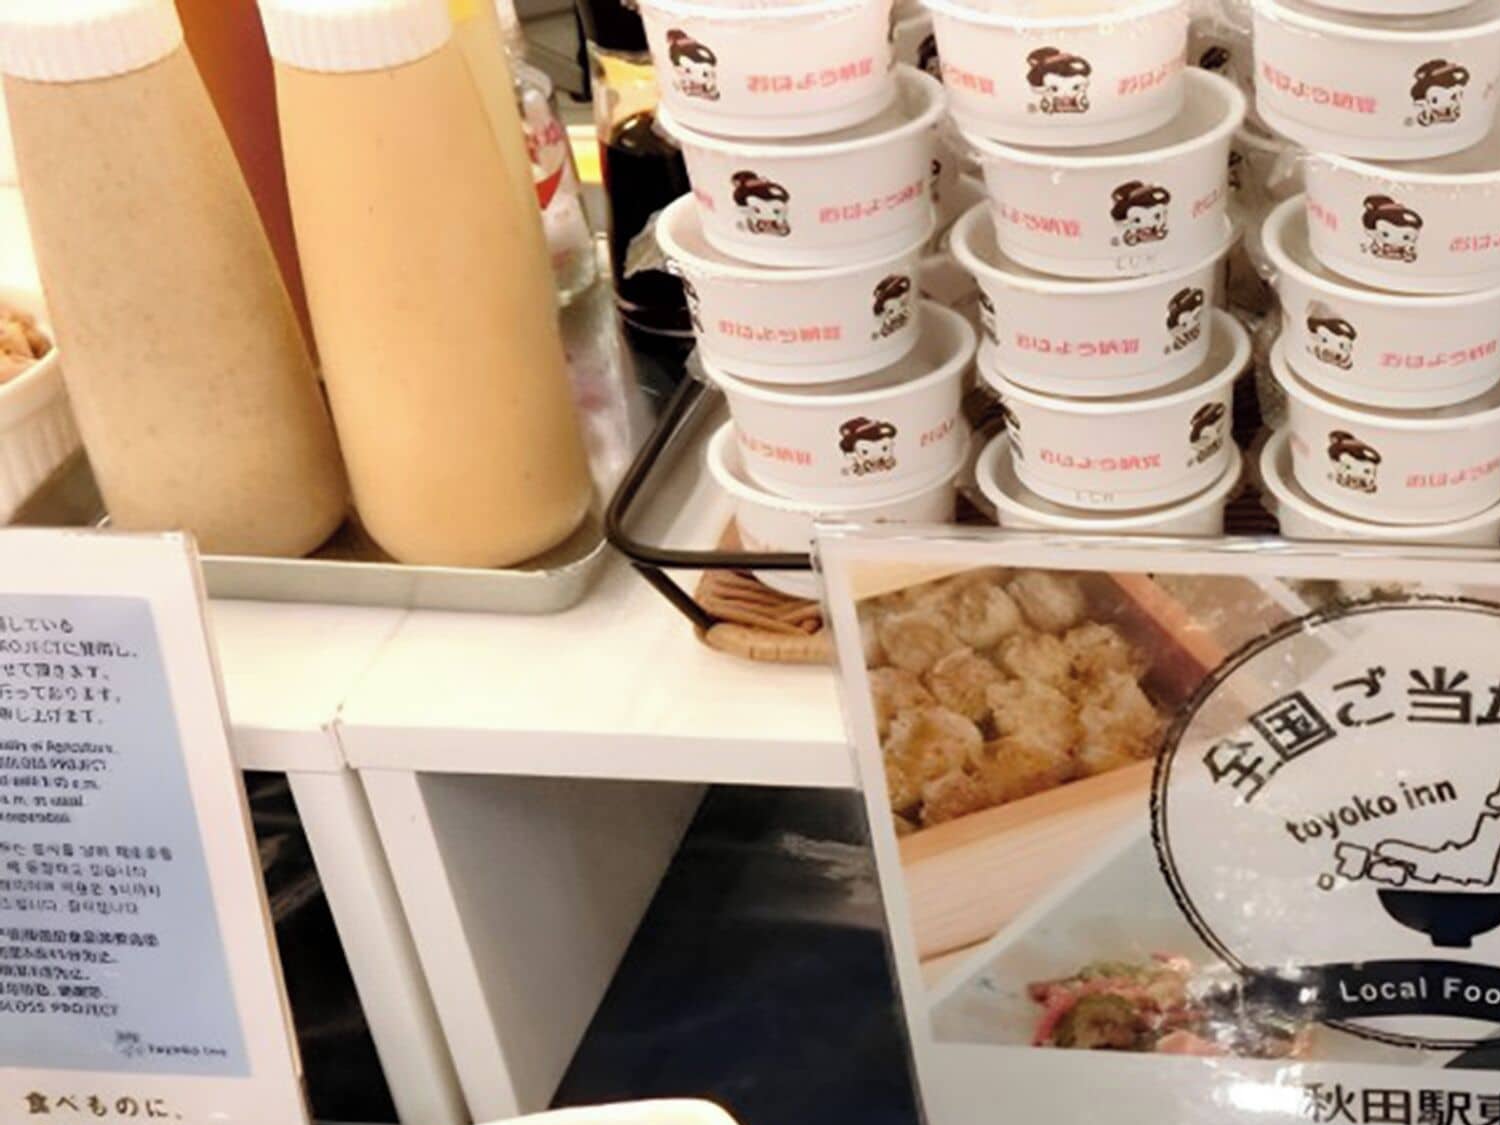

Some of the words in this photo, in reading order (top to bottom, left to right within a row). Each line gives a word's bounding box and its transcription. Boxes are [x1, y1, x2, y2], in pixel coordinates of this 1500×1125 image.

[1286, 794, 1398, 844] toyoko
[1401, 780, 1458, 810] inn
[1340, 979, 1428, 1003] Local
